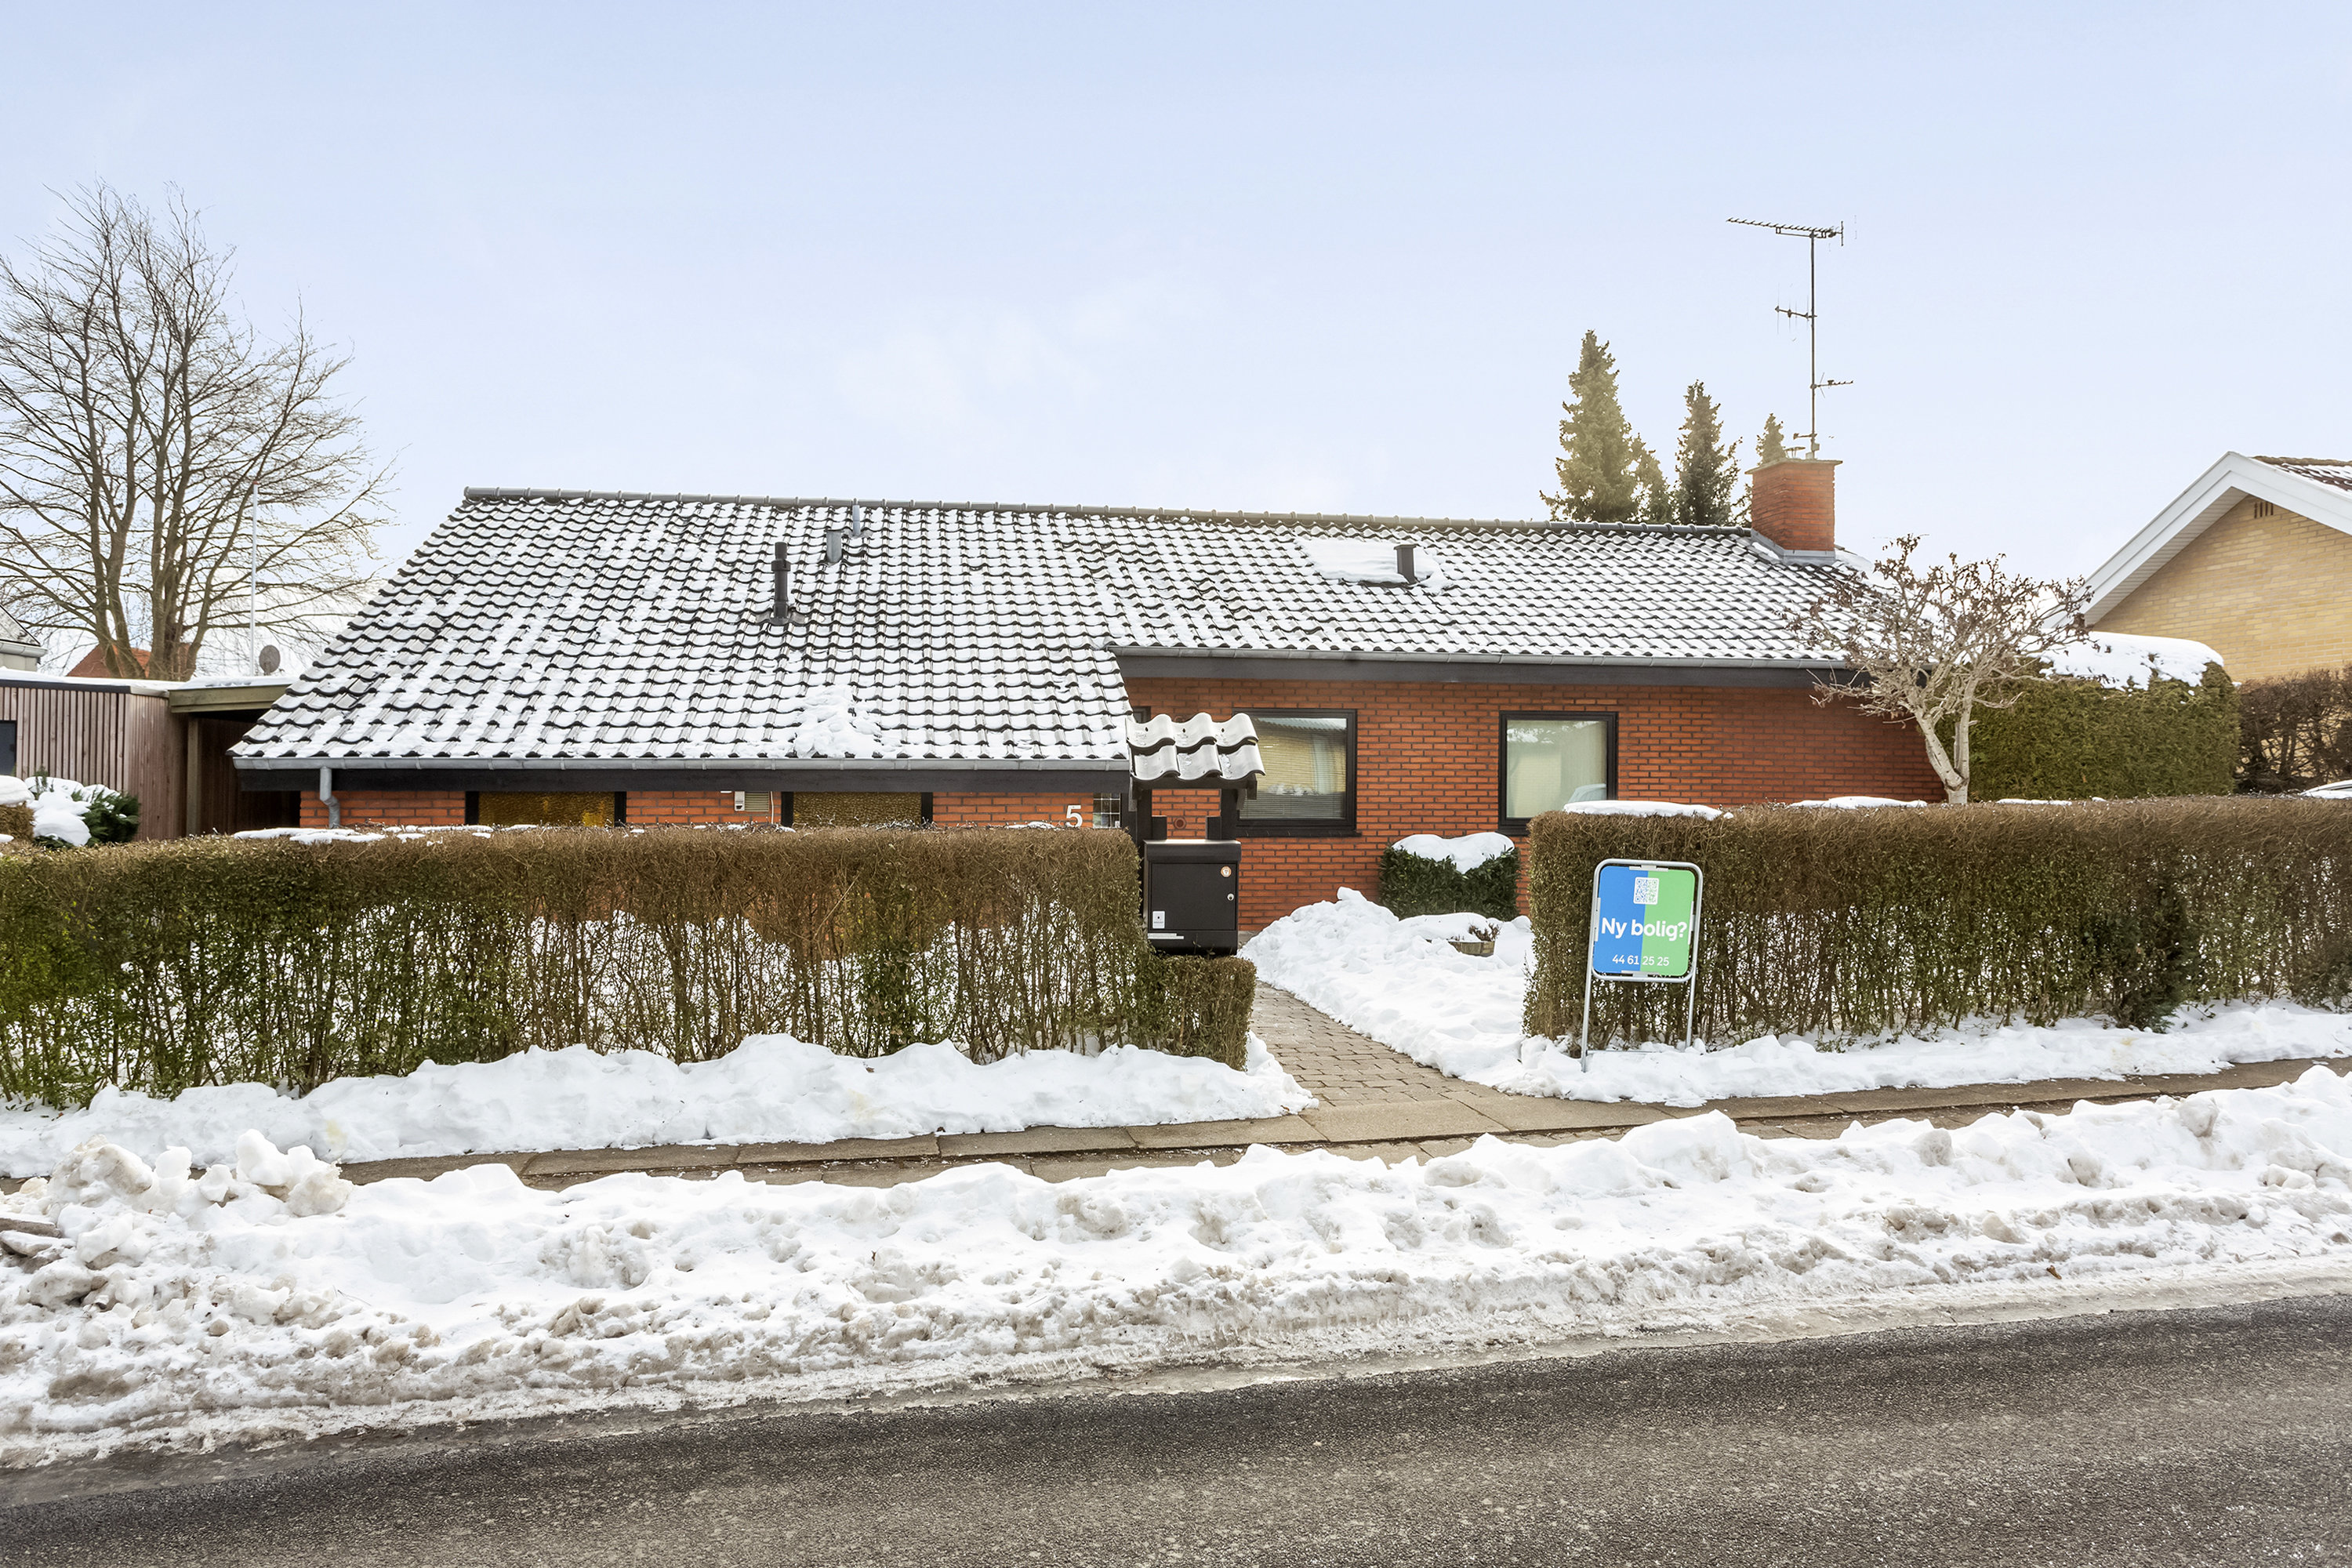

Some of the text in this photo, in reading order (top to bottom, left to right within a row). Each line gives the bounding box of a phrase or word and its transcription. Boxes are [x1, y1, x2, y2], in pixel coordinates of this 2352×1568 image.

[1065, 805, 1083, 827] 5
[1601, 917, 1687, 941] Ny bolig?
[1612, 954, 1670, 967] 44 61 25 25
